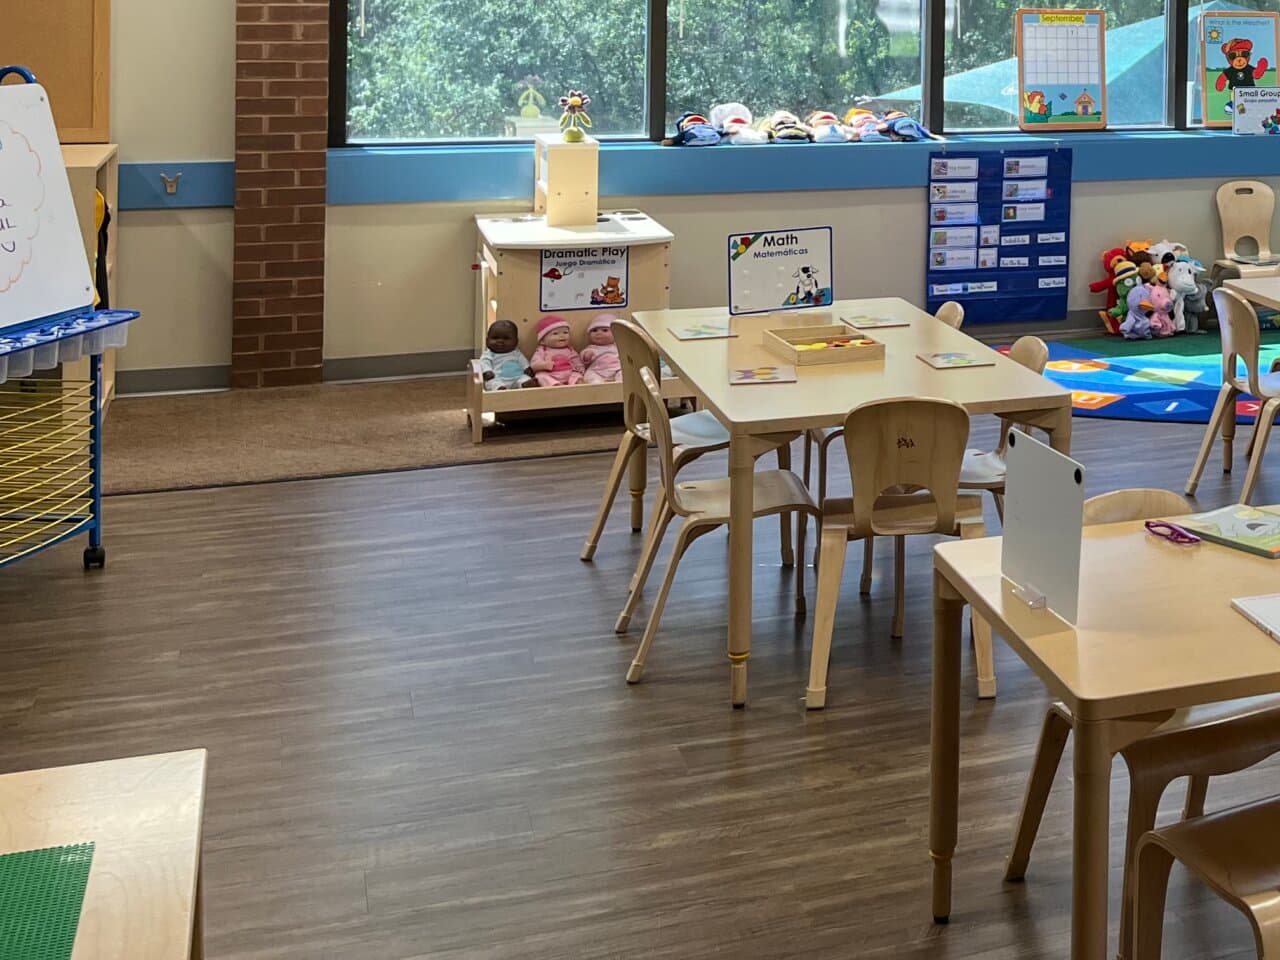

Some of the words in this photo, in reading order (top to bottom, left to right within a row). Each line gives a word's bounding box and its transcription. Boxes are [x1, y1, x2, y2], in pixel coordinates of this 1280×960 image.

[763, 234, 798, 247] Math
[544, 248, 598, 259] Dramatic
[602, 247, 626, 257] Play
[753, 248, 808, 259] Matemáticas
[556, 260, 577, 268] Juego
